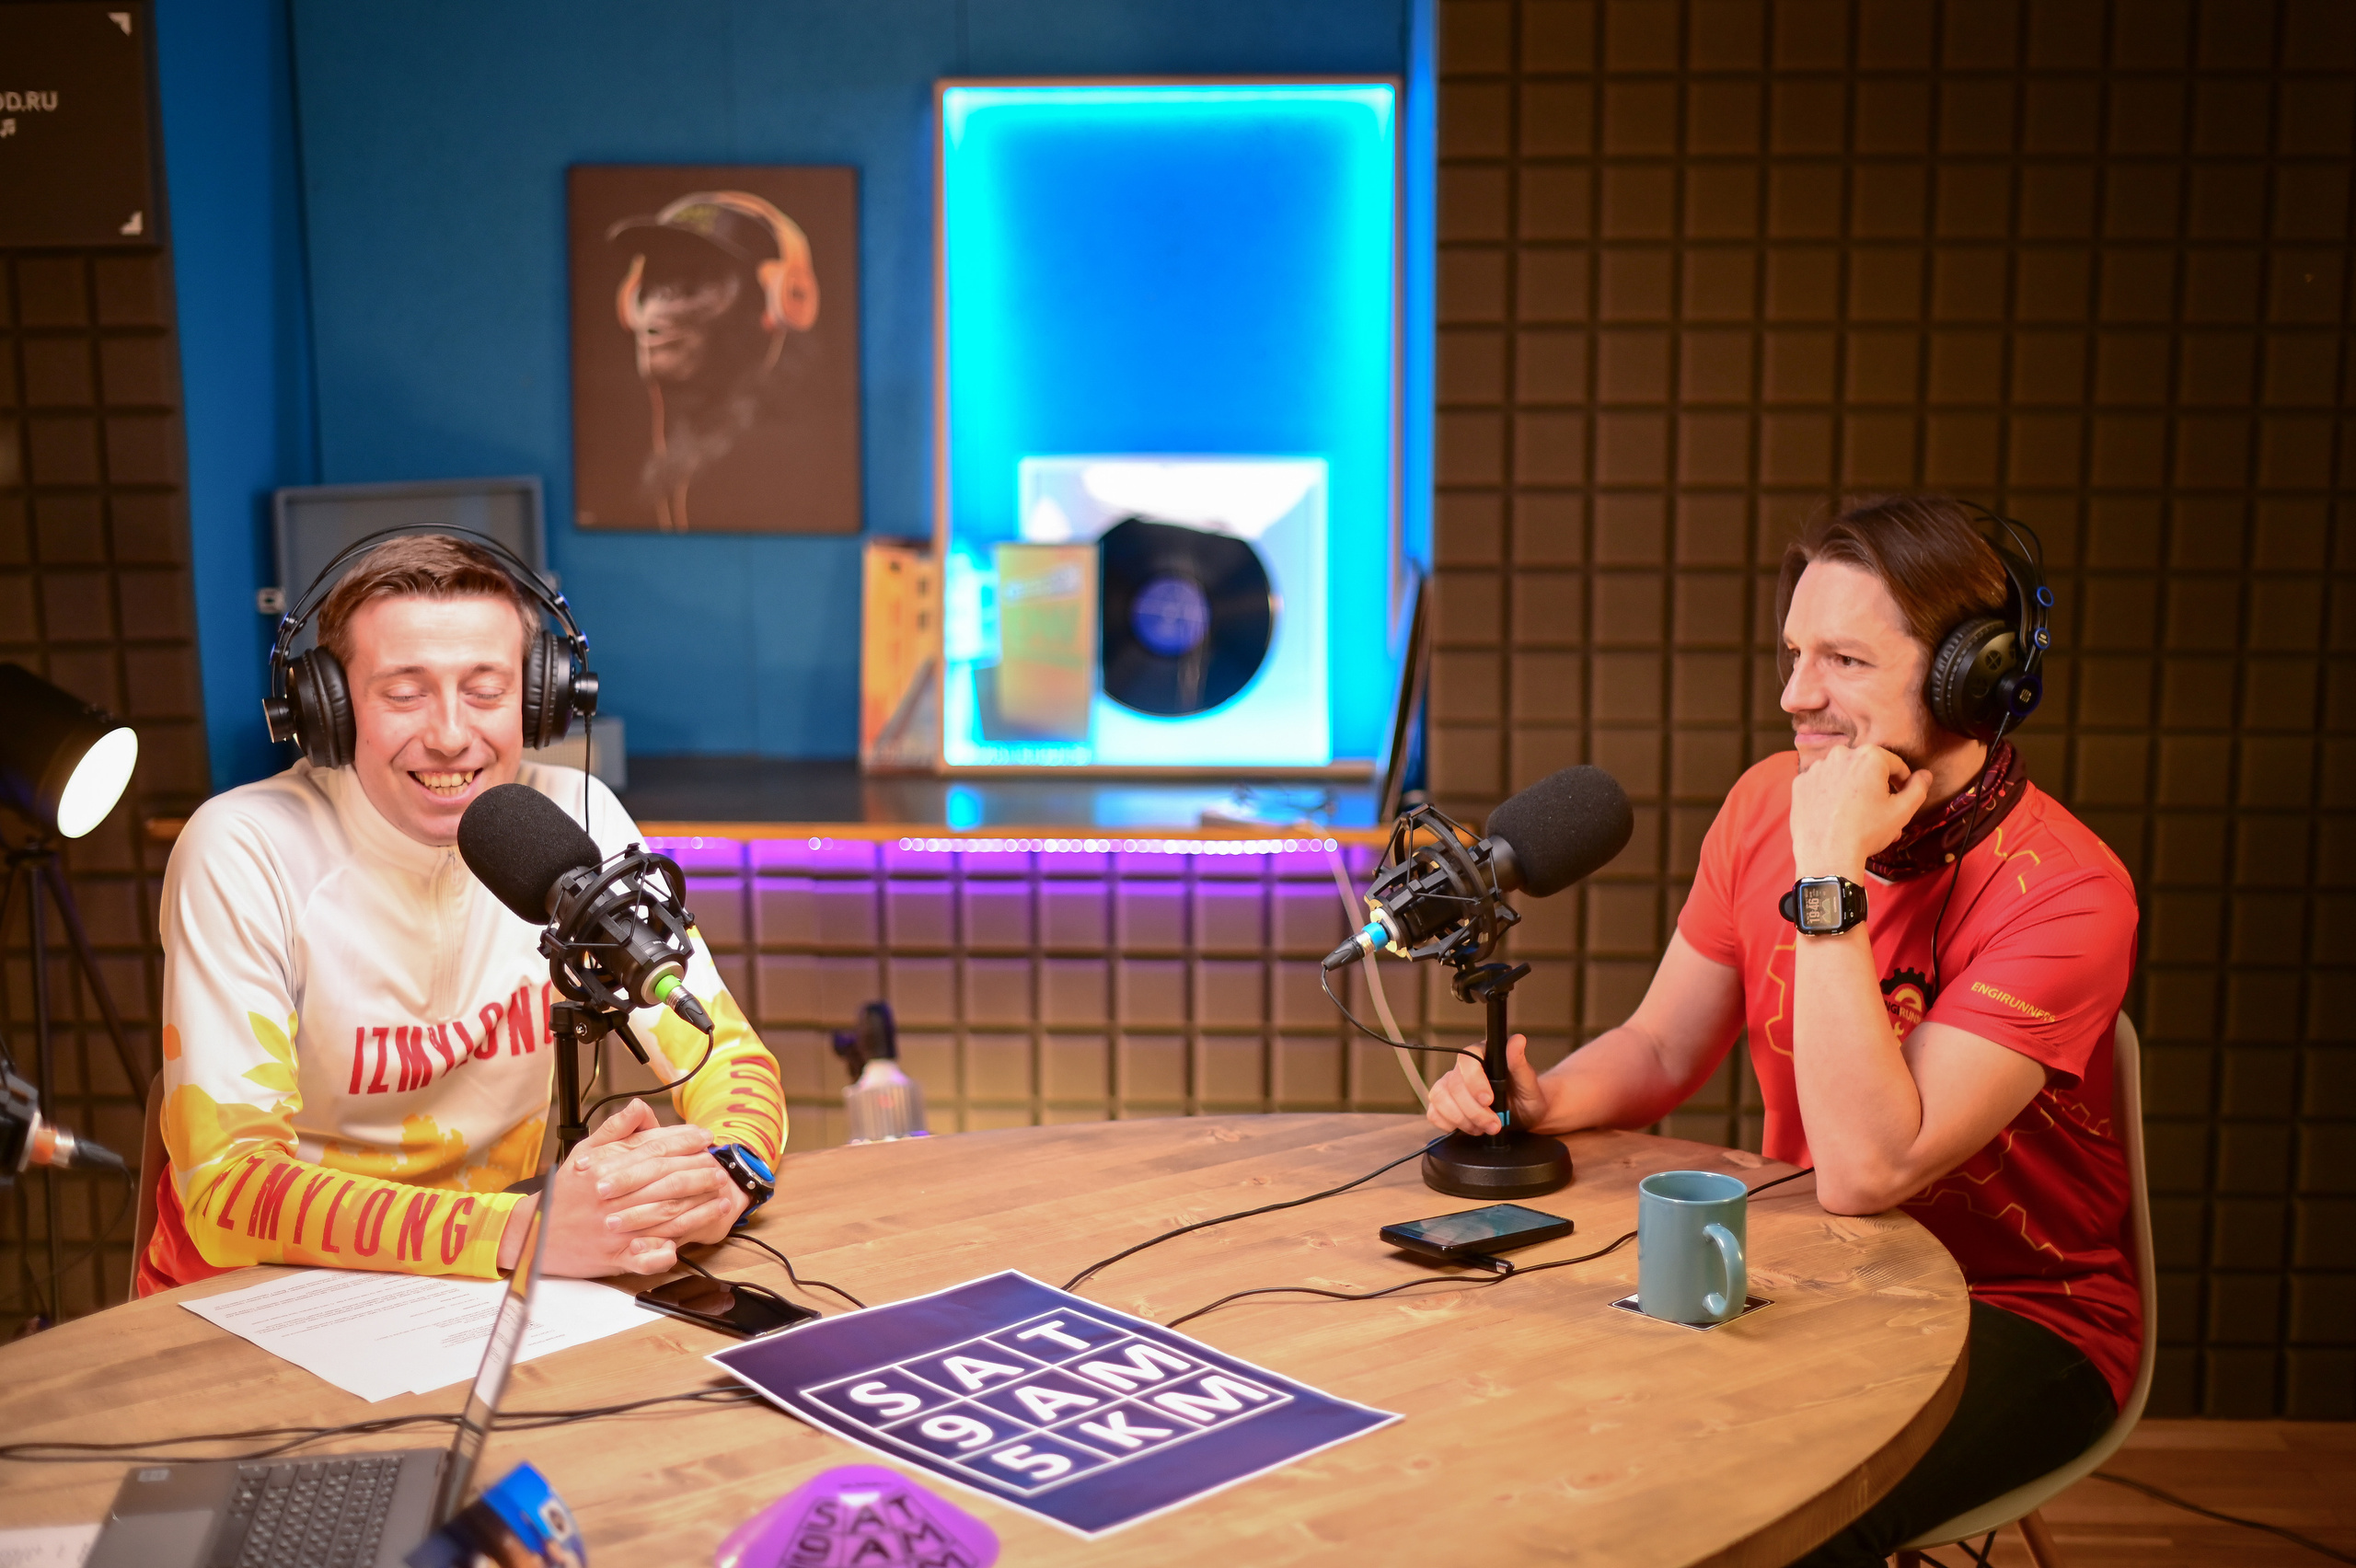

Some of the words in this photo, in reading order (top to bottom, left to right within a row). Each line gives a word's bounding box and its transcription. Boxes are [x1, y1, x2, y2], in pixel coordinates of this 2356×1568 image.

[0, 90, 58, 111] D.RU
[849, 1320, 1091, 1417] SAT
[920, 1343, 1192, 1448] 9AM
[991, 1374, 1270, 1481] 5KM
